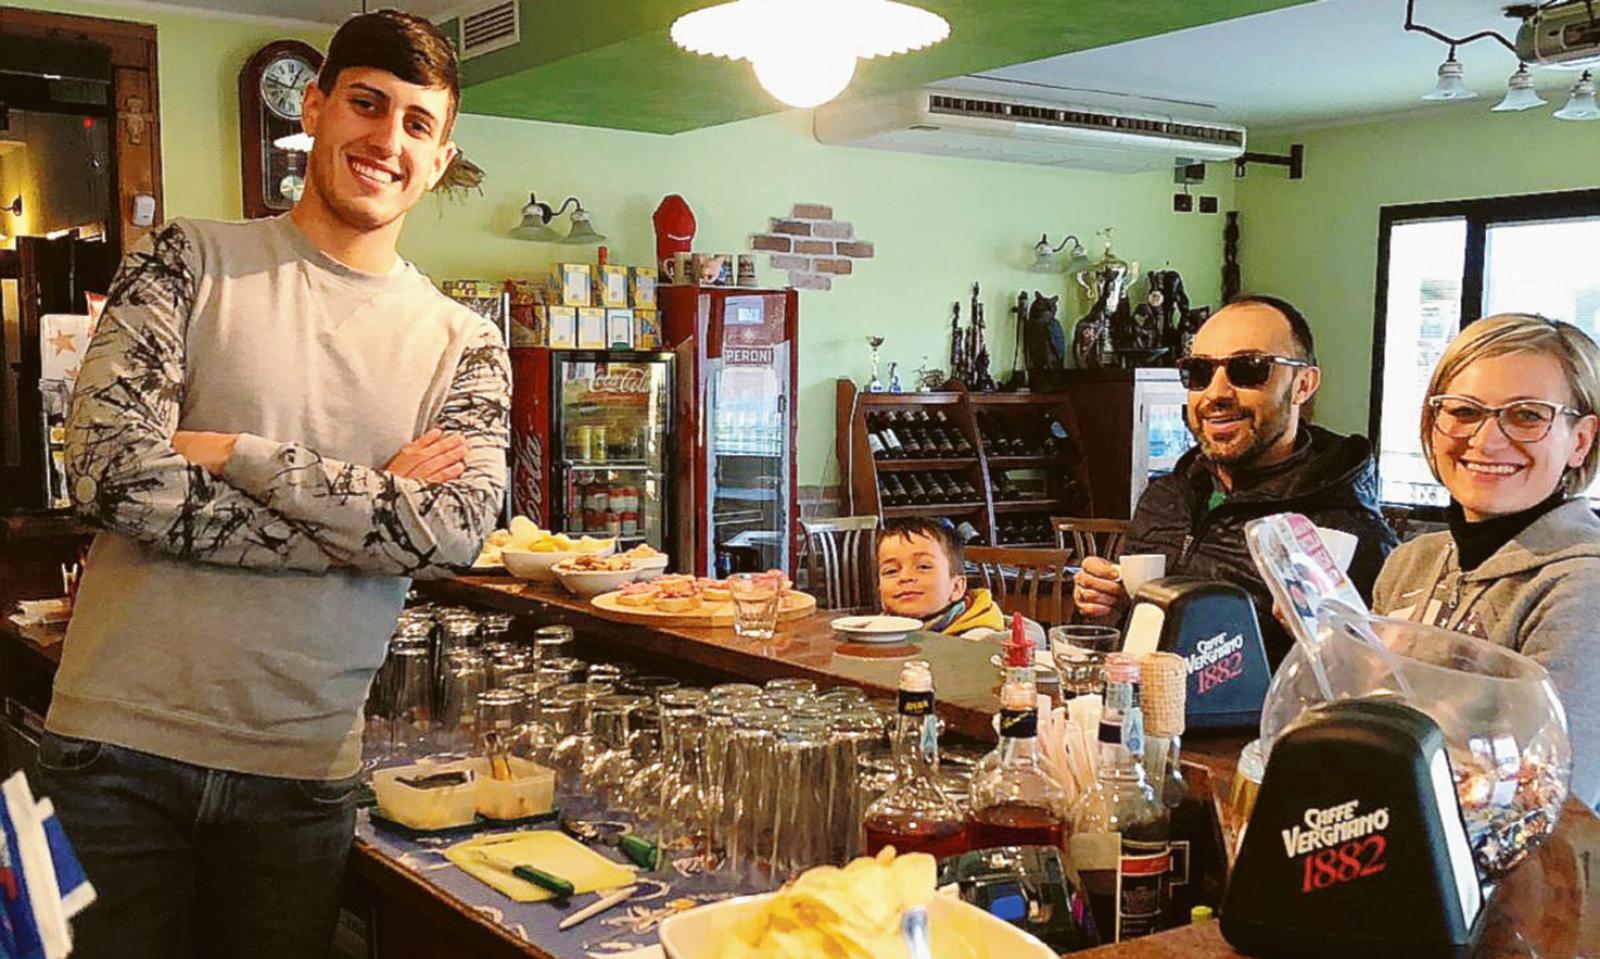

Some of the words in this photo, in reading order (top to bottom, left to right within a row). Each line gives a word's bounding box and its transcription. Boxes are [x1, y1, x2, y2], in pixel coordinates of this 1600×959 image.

[726, 349, 772, 362] PERONI
[1197, 651, 1243, 694] 1882
[1303, 834, 1386, 892] 1882
